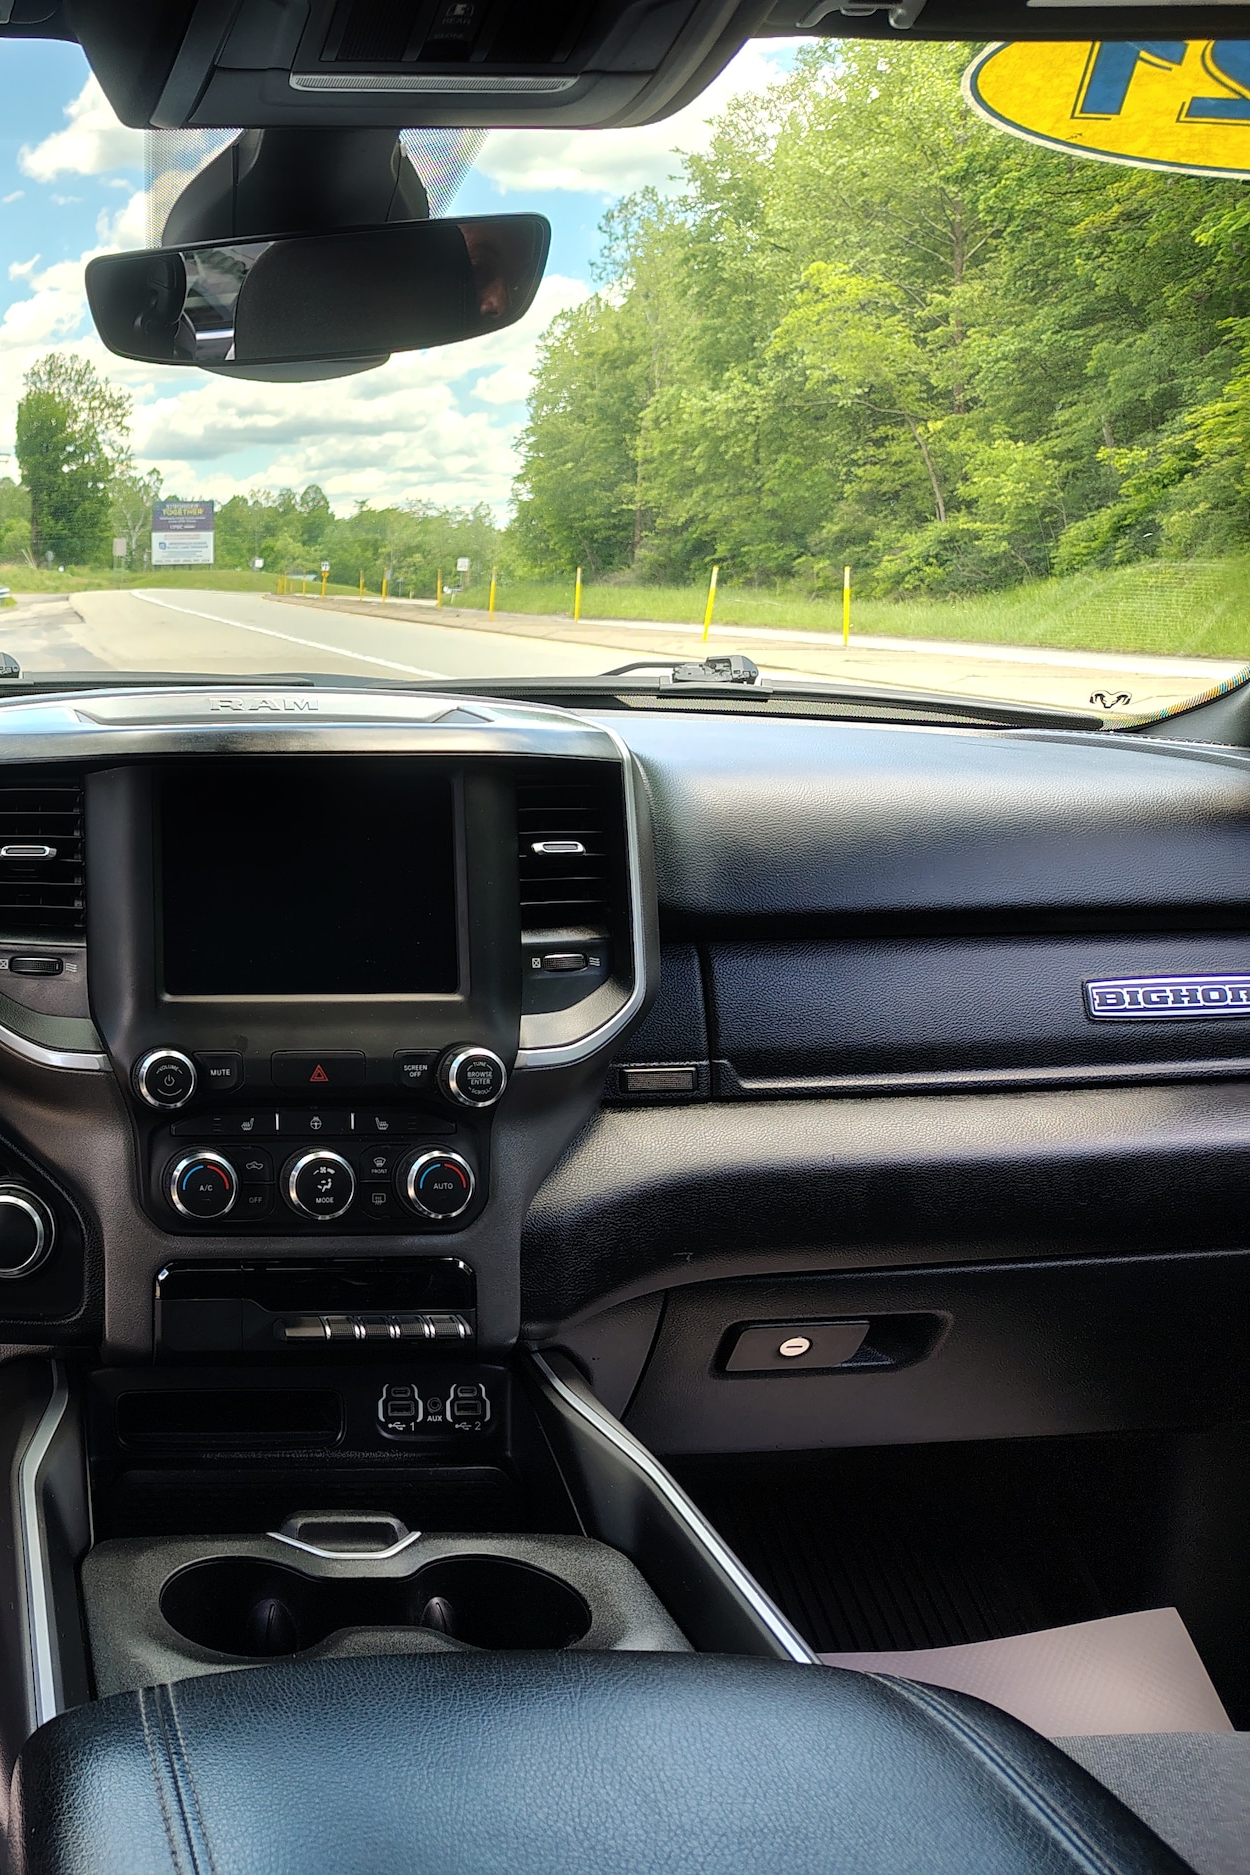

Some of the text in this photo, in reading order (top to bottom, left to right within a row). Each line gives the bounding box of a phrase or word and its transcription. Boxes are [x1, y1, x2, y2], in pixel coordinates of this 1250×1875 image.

[441, 17, 471, 25] REAR
[208, 696, 319, 711] RAM
[158, 1064, 180, 1072] VOLUME
[210, 1068, 231, 1076] MUTE
[198, 1184, 213, 1192] A/C
[432, 1182, 454, 1190] AUTO
[248, 1196, 263, 1204] OFF
[409, 1422, 415, 1431] 1
[474, 1421, 482, 1431] 2
